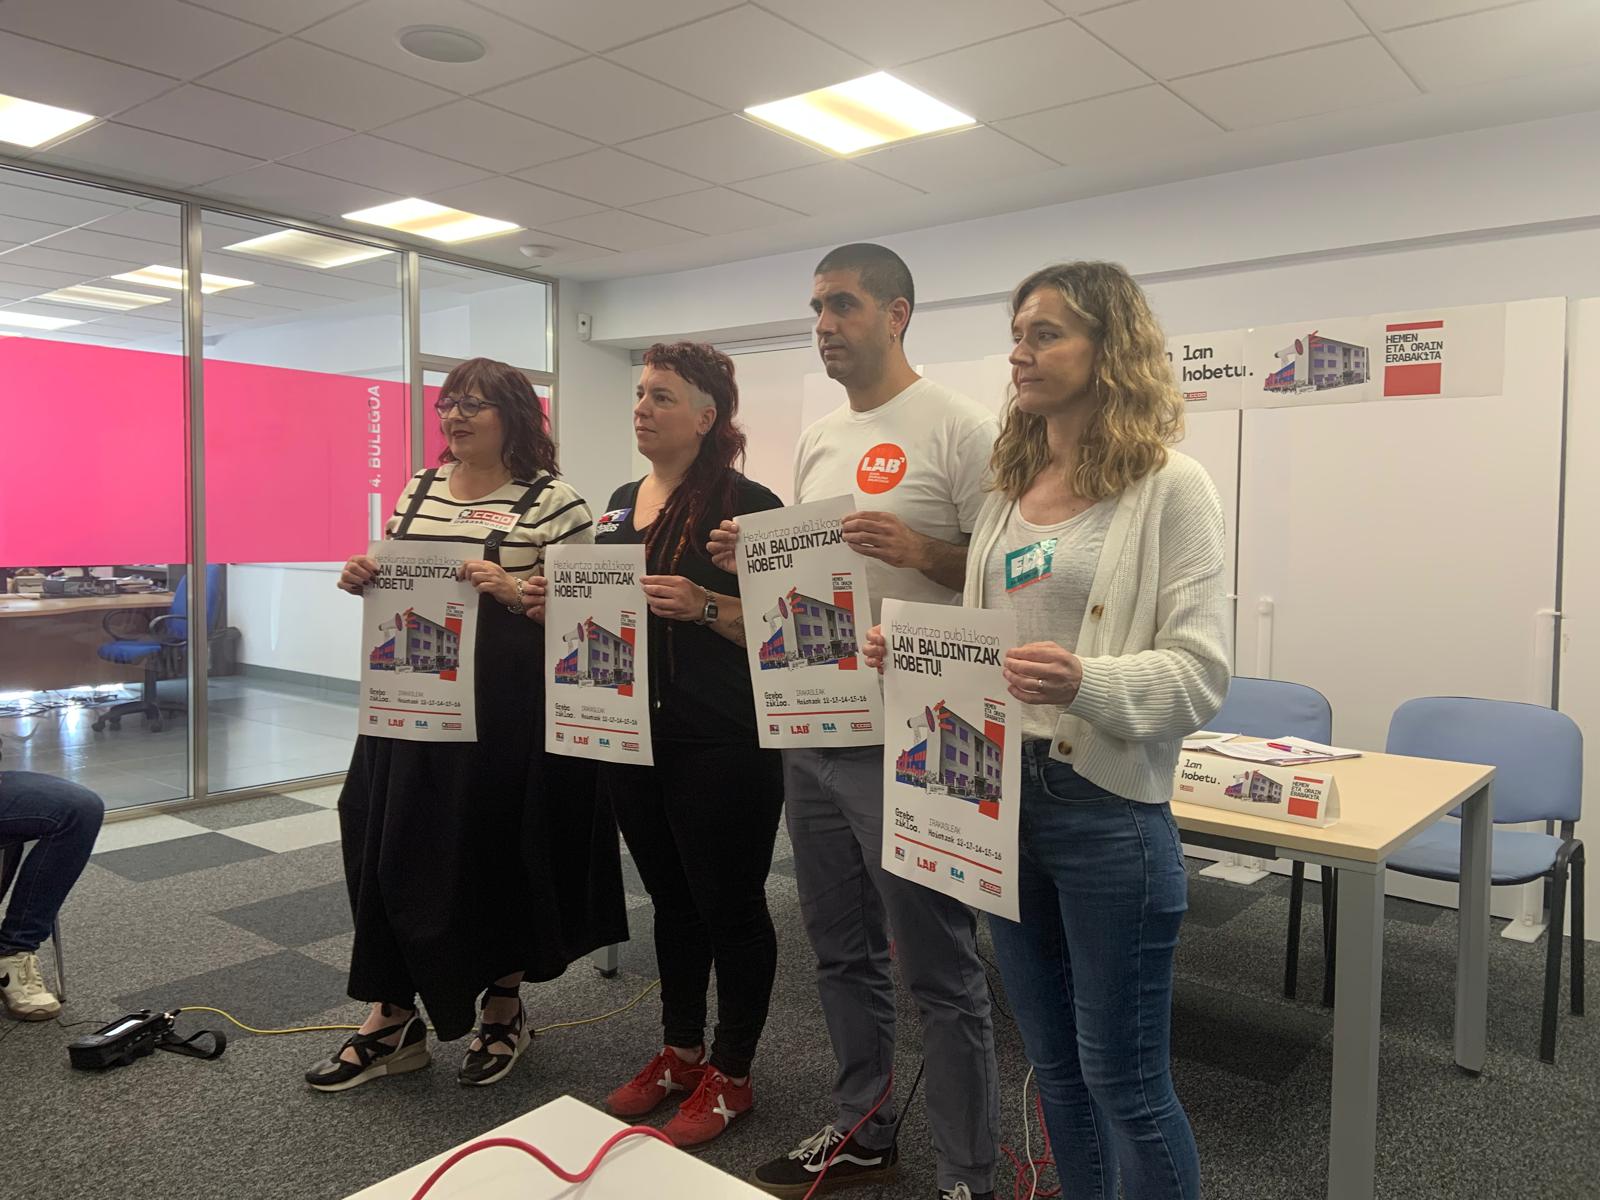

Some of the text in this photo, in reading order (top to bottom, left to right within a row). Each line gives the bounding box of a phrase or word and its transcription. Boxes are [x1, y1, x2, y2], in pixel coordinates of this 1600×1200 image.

[1386, 333, 1418, 344] HEMEN
[1183, 345, 1213, 360] lan
[1386, 341, 1443, 353] ETA ORAIN
[1182, 363, 1253, 382] hobetu.
[368, 386, 381, 468] BULEGOA
[861, 456, 905, 473] LAB
[472, 511, 513, 525] CCOO
[744, 527, 790, 542] Hezkuntza
[745, 528, 846, 558] LAN BALDINTZAK
[747, 553, 793, 574] HOBETU!
[379, 564, 457, 579] AN BALDINTZA
[554, 571, 635, 585] LAN BALDINTZAK
[554, 585, 592, 599] HOBETU!
[891, 620, 1000, 646] Hezkuntza publikoan
[892, 635, 1001, 666] LAN BALDINTZAK
[893, 653, 942, 677] HOBETU!
[388, 718, 405, 727] LAB
[790, 723, 810, 734] LAB
[574, 736, 589, 745] LAB
[1184, 759, 1202, 770] lan
[1181, 769, 1220, 785] hobetu.
[917, 857, 937, 872] LAB
[951, 867, 964, 880] ELA
